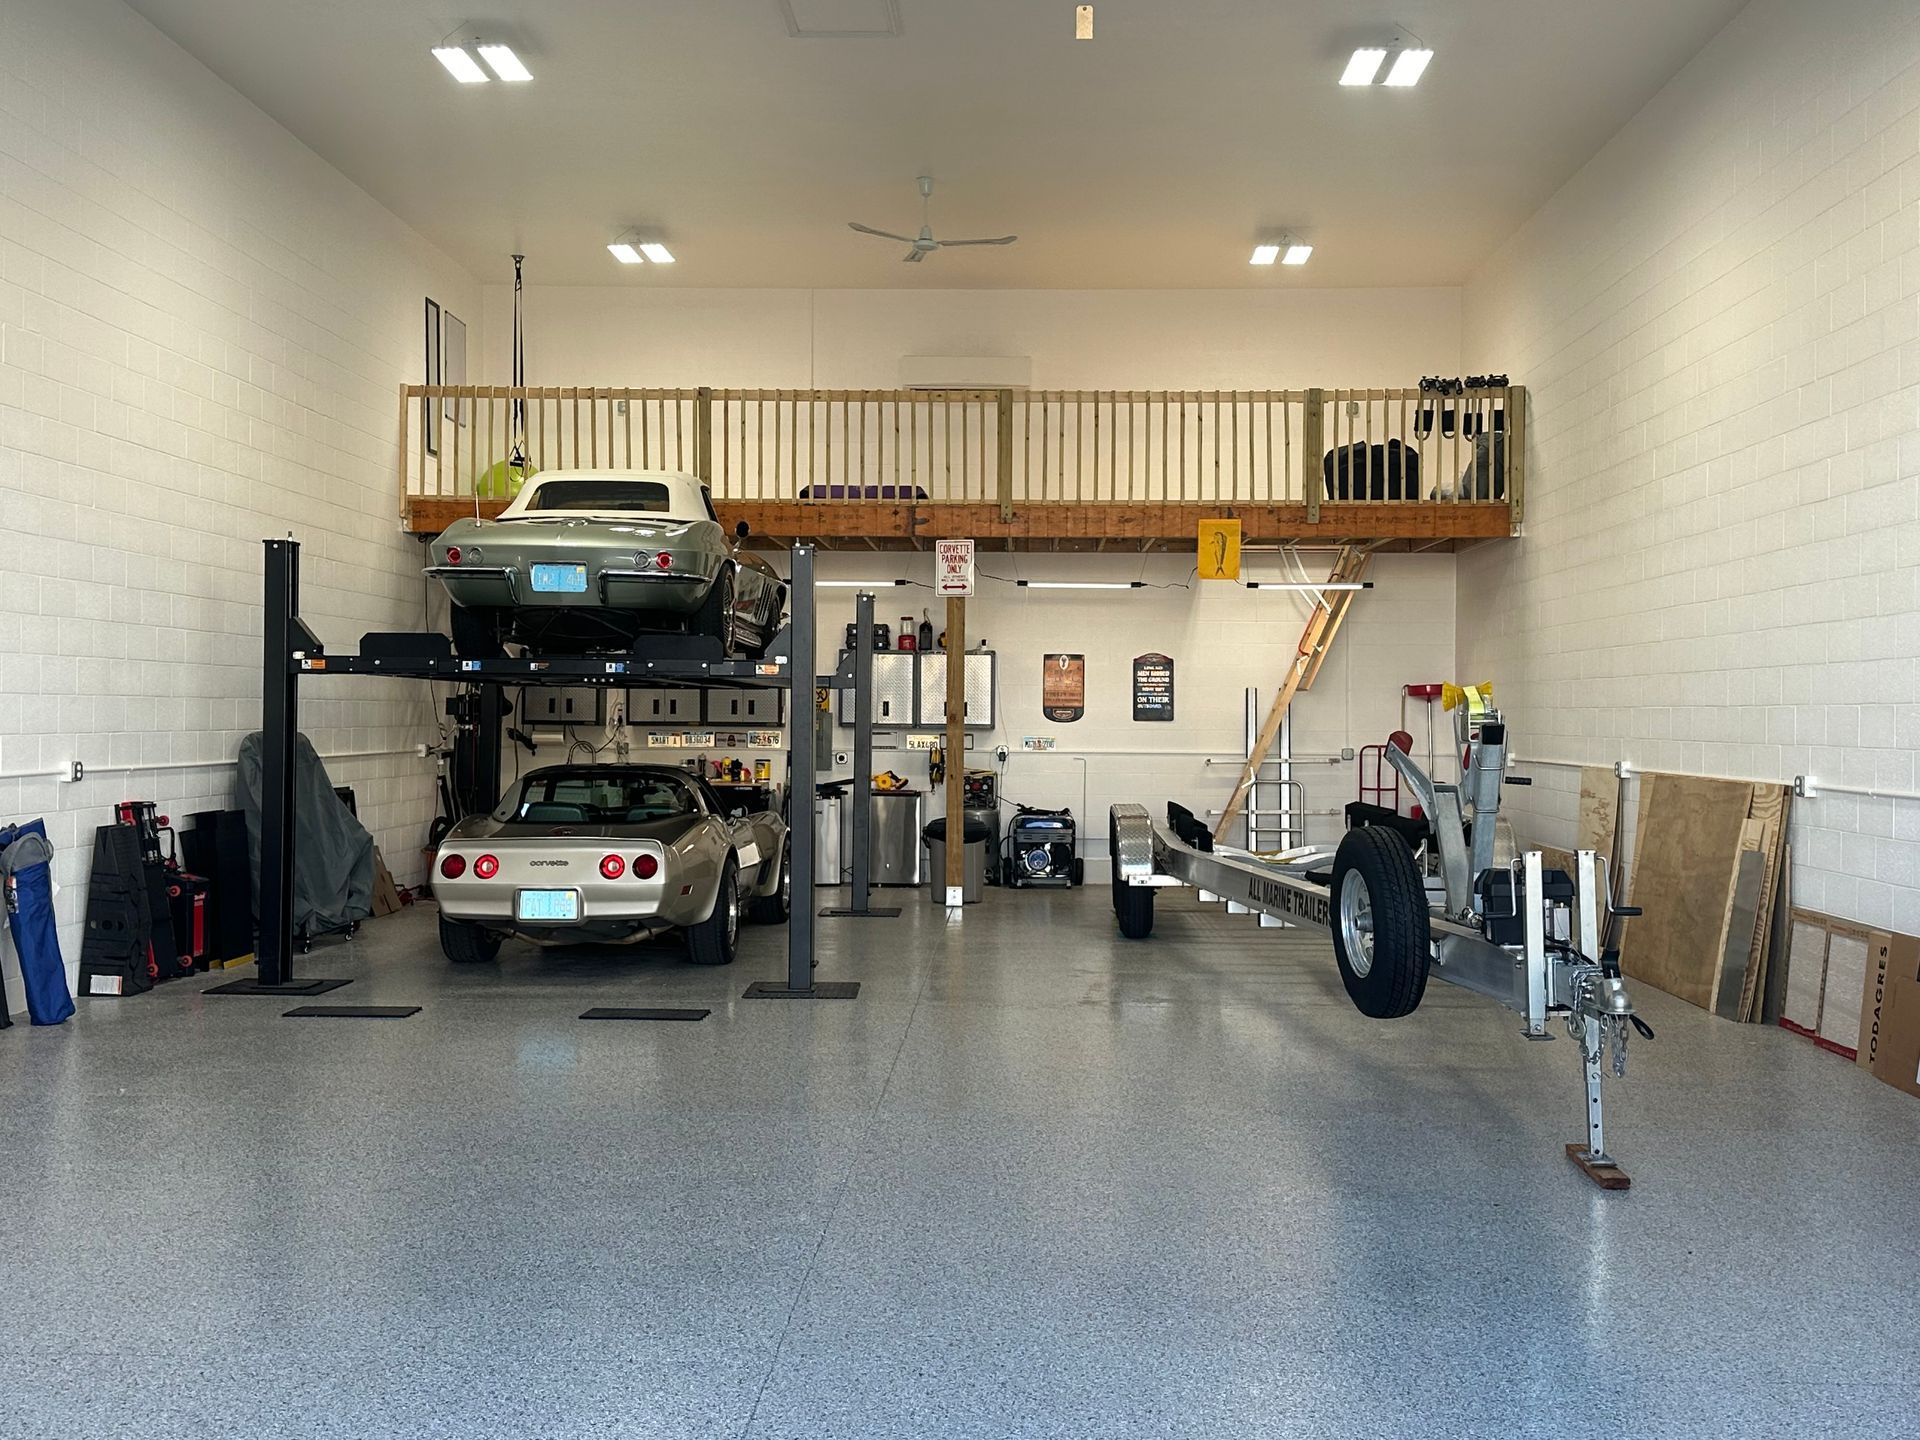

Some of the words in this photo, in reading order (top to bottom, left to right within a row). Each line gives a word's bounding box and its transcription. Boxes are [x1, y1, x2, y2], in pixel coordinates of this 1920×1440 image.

[939, 544, 970, 554] CORVETTE
[941, 554, 968, 564] PARKING
[946, 564, 962, 574] ONLY
[1248, 877, 1261, 902] ALL
[1263, 881, 1292, 912] MARINE
[1293, 892, 1332, 927] TRAILER
[1868, 946, 1888, 1064] TODAGRES
